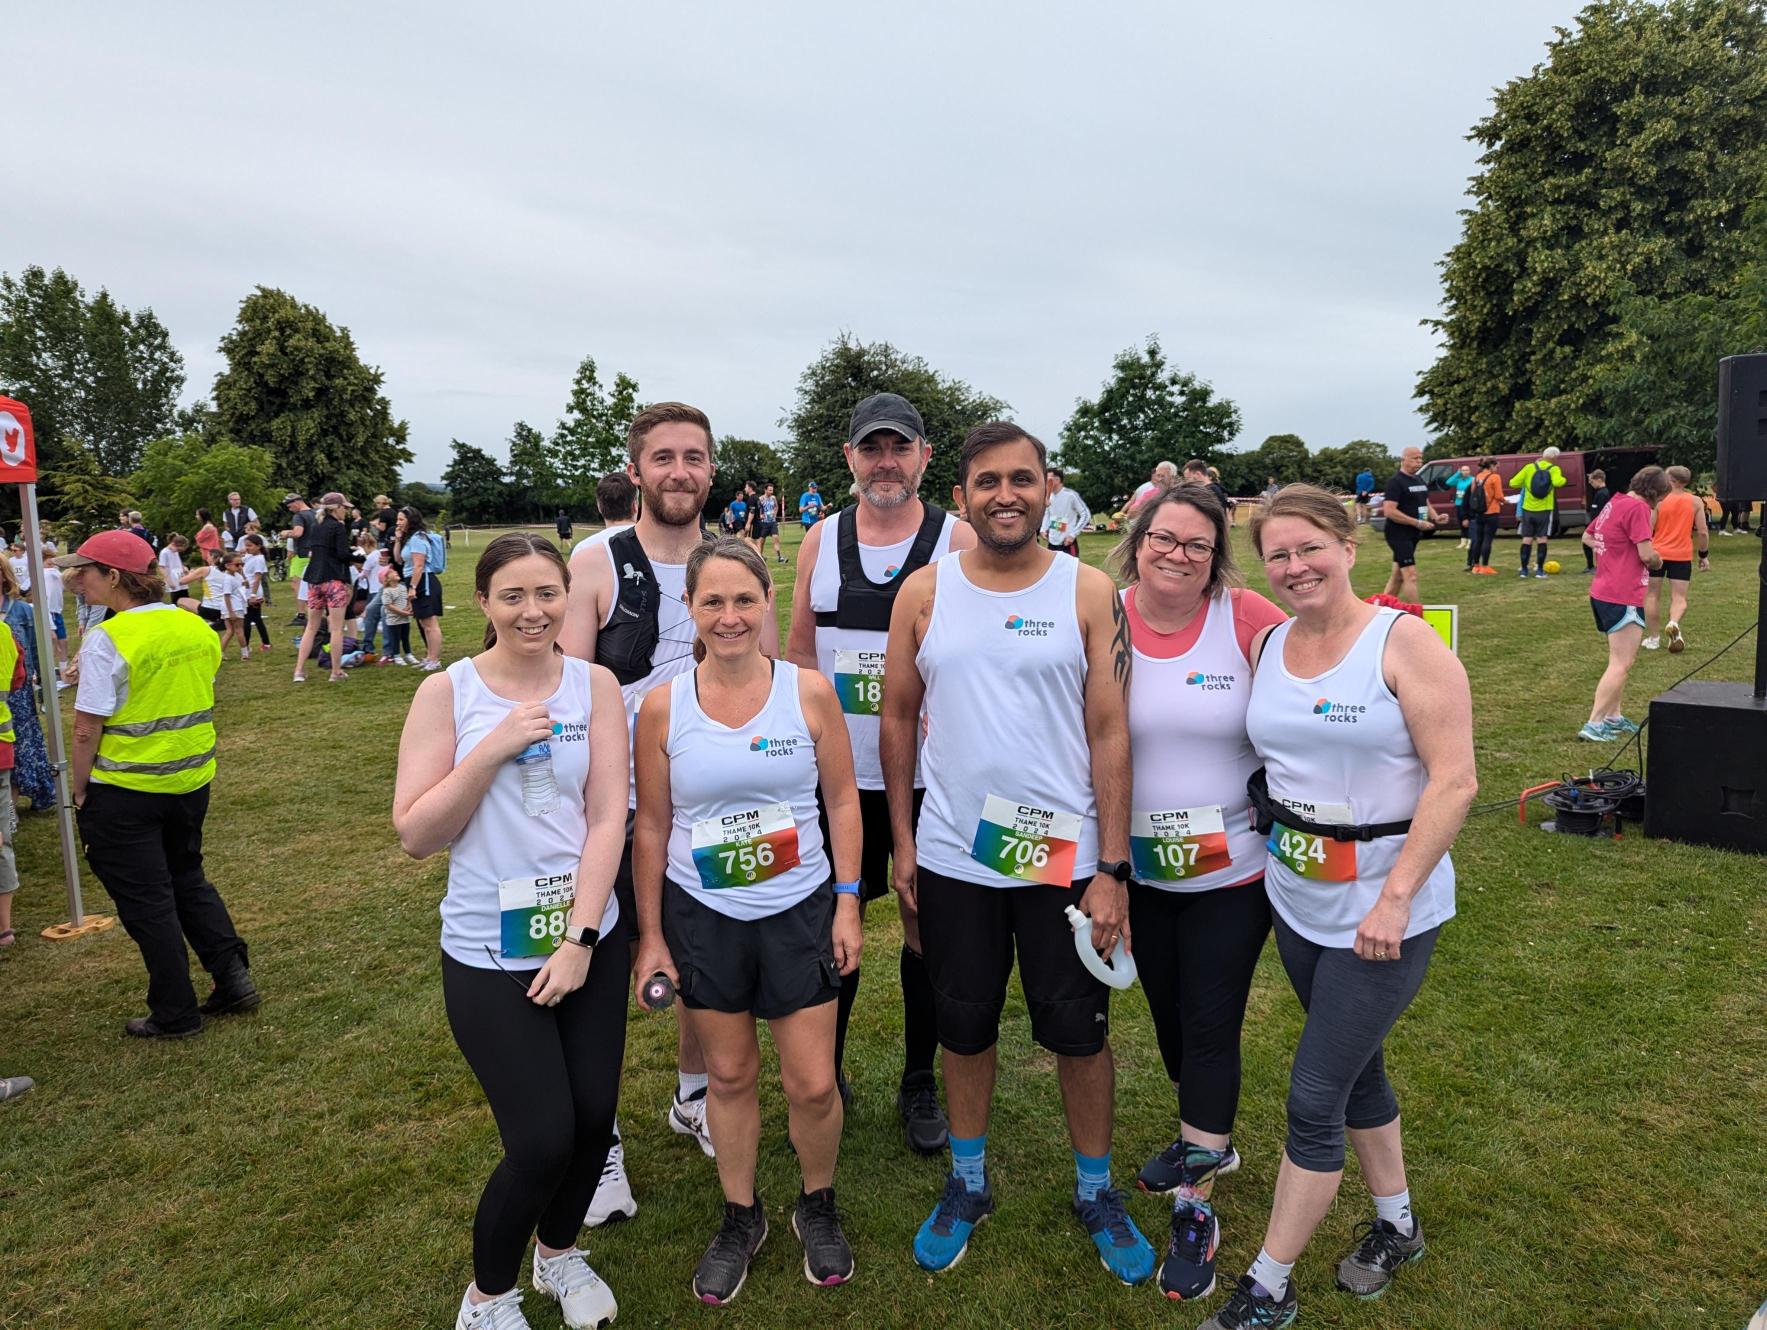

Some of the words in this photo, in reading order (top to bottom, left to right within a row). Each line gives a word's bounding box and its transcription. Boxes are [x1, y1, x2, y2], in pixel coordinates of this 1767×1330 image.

[1024, 619, 1055, 628] three
[1018, 627, 1048, 637] rocks
[1205, 674, 1235, 682] three
[854, 680, 886, 703] 18
[1201, 681, 1231, 691] rocks
[1332, 703, 1366, 713] three
[1324, 712, 1358, 723] rocks
[563, 723, 588, 733] three
[560, 732, 585, 743] rocks
[769, 738, 798, 748] three
[765, 747, 794, 757] rocks
[1282, 799, 1316, 813] CPM
[721, 809, 760, 826] CPM
[1017, 805, 1055, 820] CPM
[1150, 811, 1189, 821] CPM
[722, 825, 748, 837] THAME
[748, 822, 761, 831] 10K
[1015, 818, 1038, 827] THAME
[1039, 822, 1050, 830] 10K
[1178, 822, 1190, 830] 10K
[735, 839, 753, 848] KATE
[1280, 831, 1327, 864] 424
[1000, 835, 1050, 868] 706
[1153, 844, 1200, 867] 107
[718, 842, 775, 875] 756
[534, 872, 573, 888] CPM
[536, 888, 561, 898] THAME
[563, 885, 574, 894] 10K
